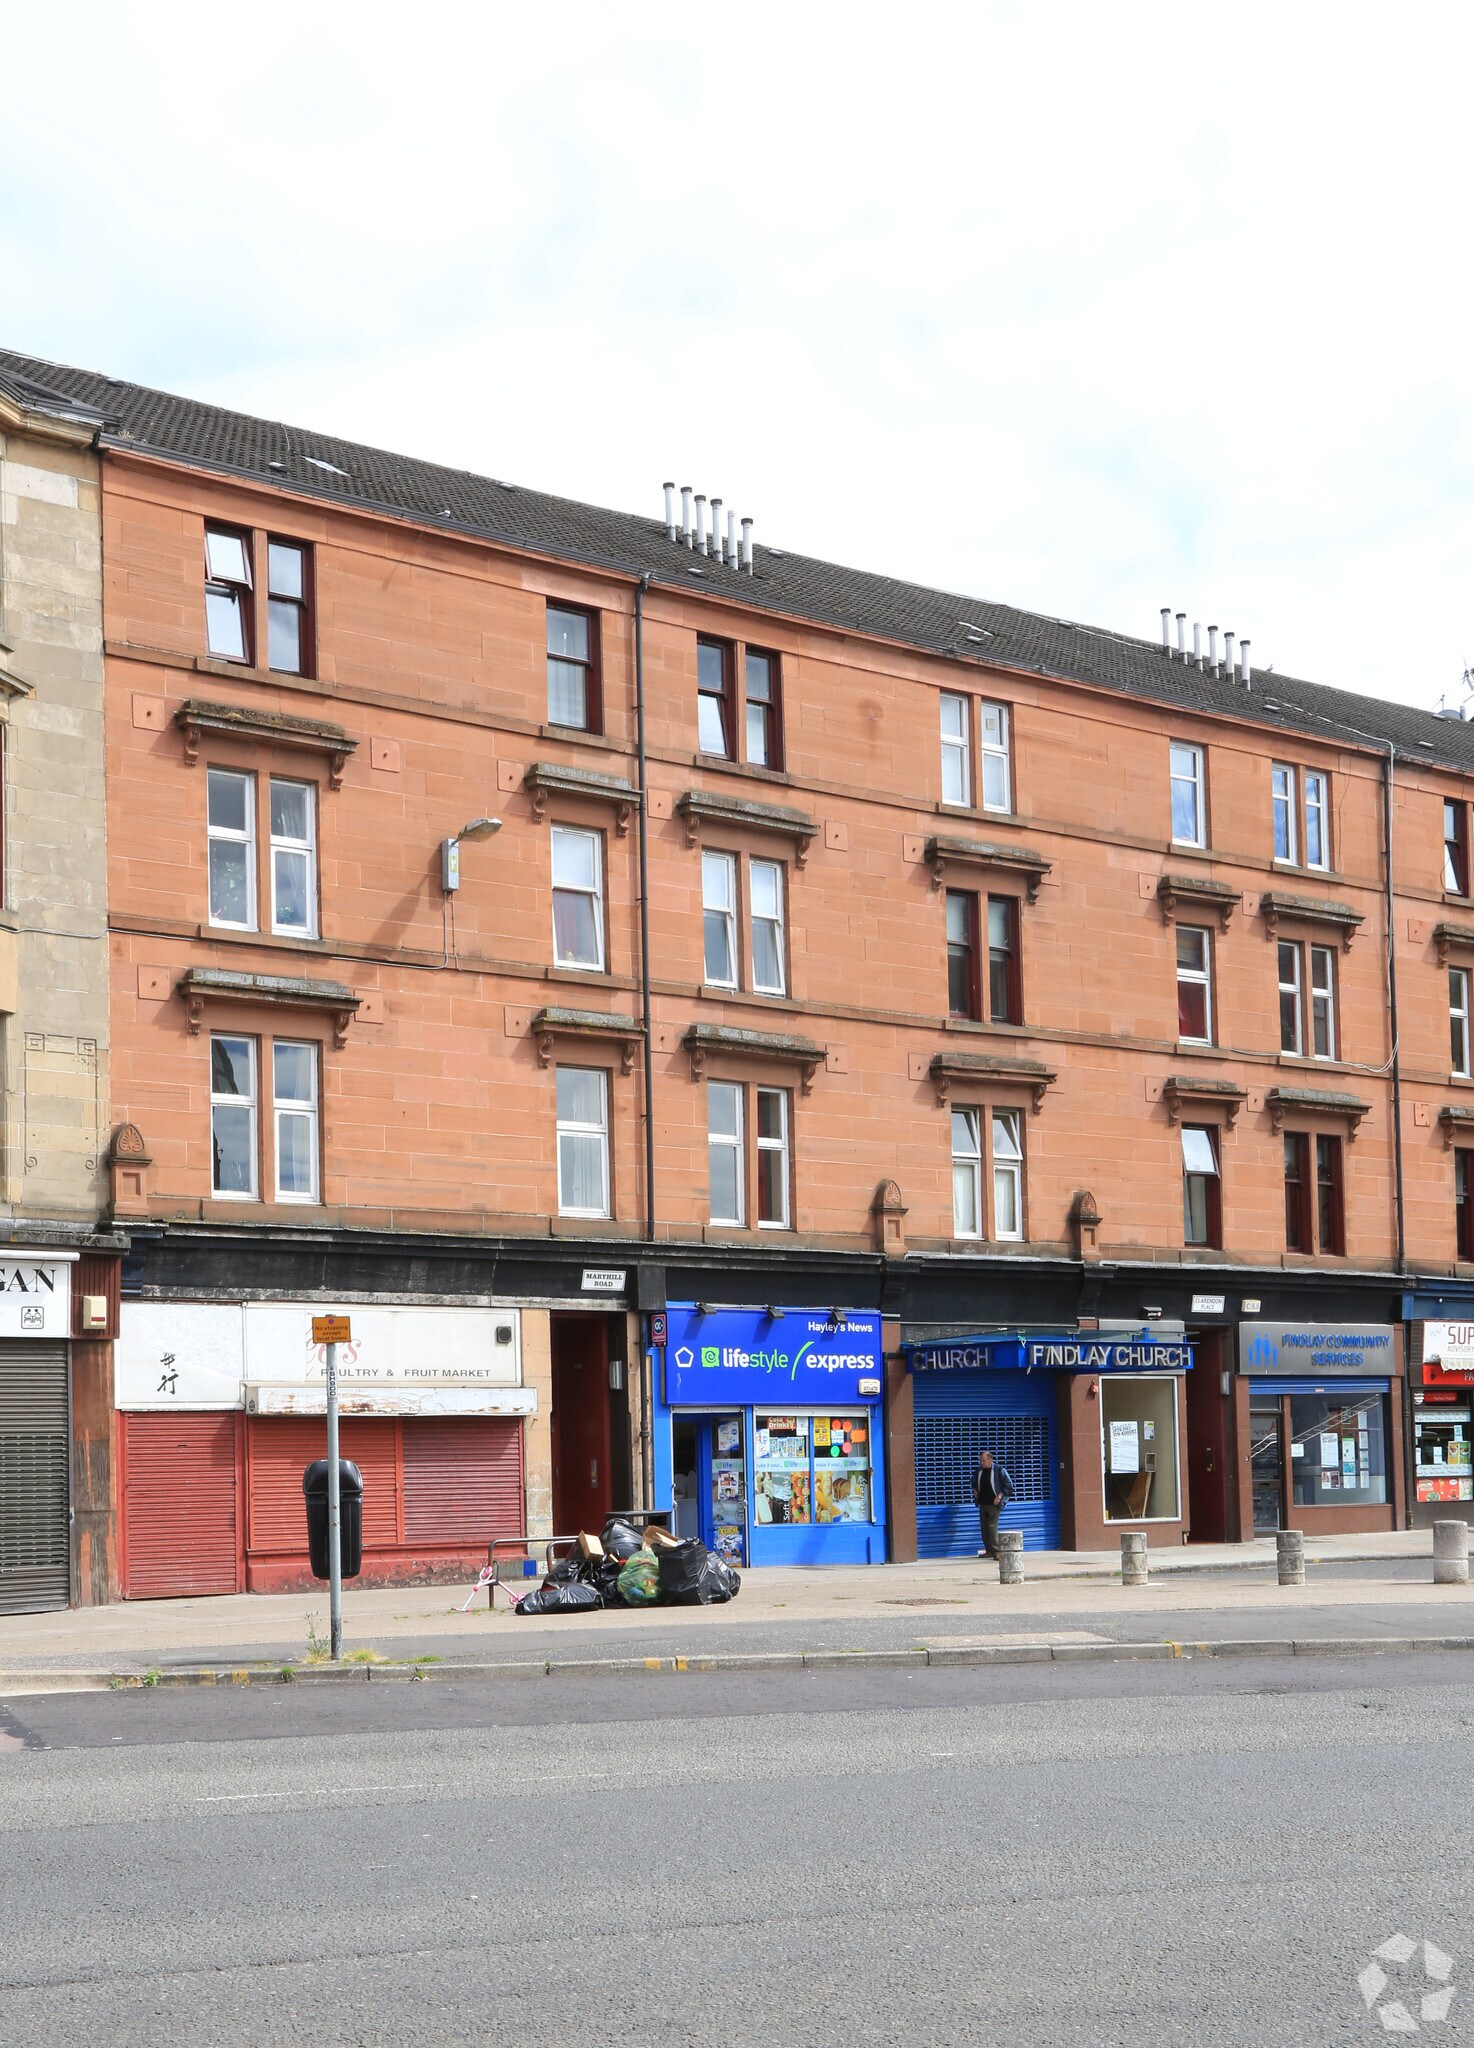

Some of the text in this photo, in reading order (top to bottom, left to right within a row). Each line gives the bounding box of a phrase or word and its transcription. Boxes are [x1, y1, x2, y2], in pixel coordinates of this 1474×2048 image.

[0, 1267, 57, 1293] AN
[808, 1321, 873, 1334] Hayley's News
[1282, 1334, 1390, 1348] FINDLAY COMMUNITY
[723, 1347, 789, 1374] lifestyle
[806, 1354, 875, 1373] express
[911, 1348, 989, 1371] CHURCH
[1113, 1346, 1192, 1368] CHURCH
[1311, 1352, 1364, 1366] SERVICES
[321, 1368, 491, 1377] PULTRY & FRUIT MARKET
[857, 1475, 867, 1519] Grocery
